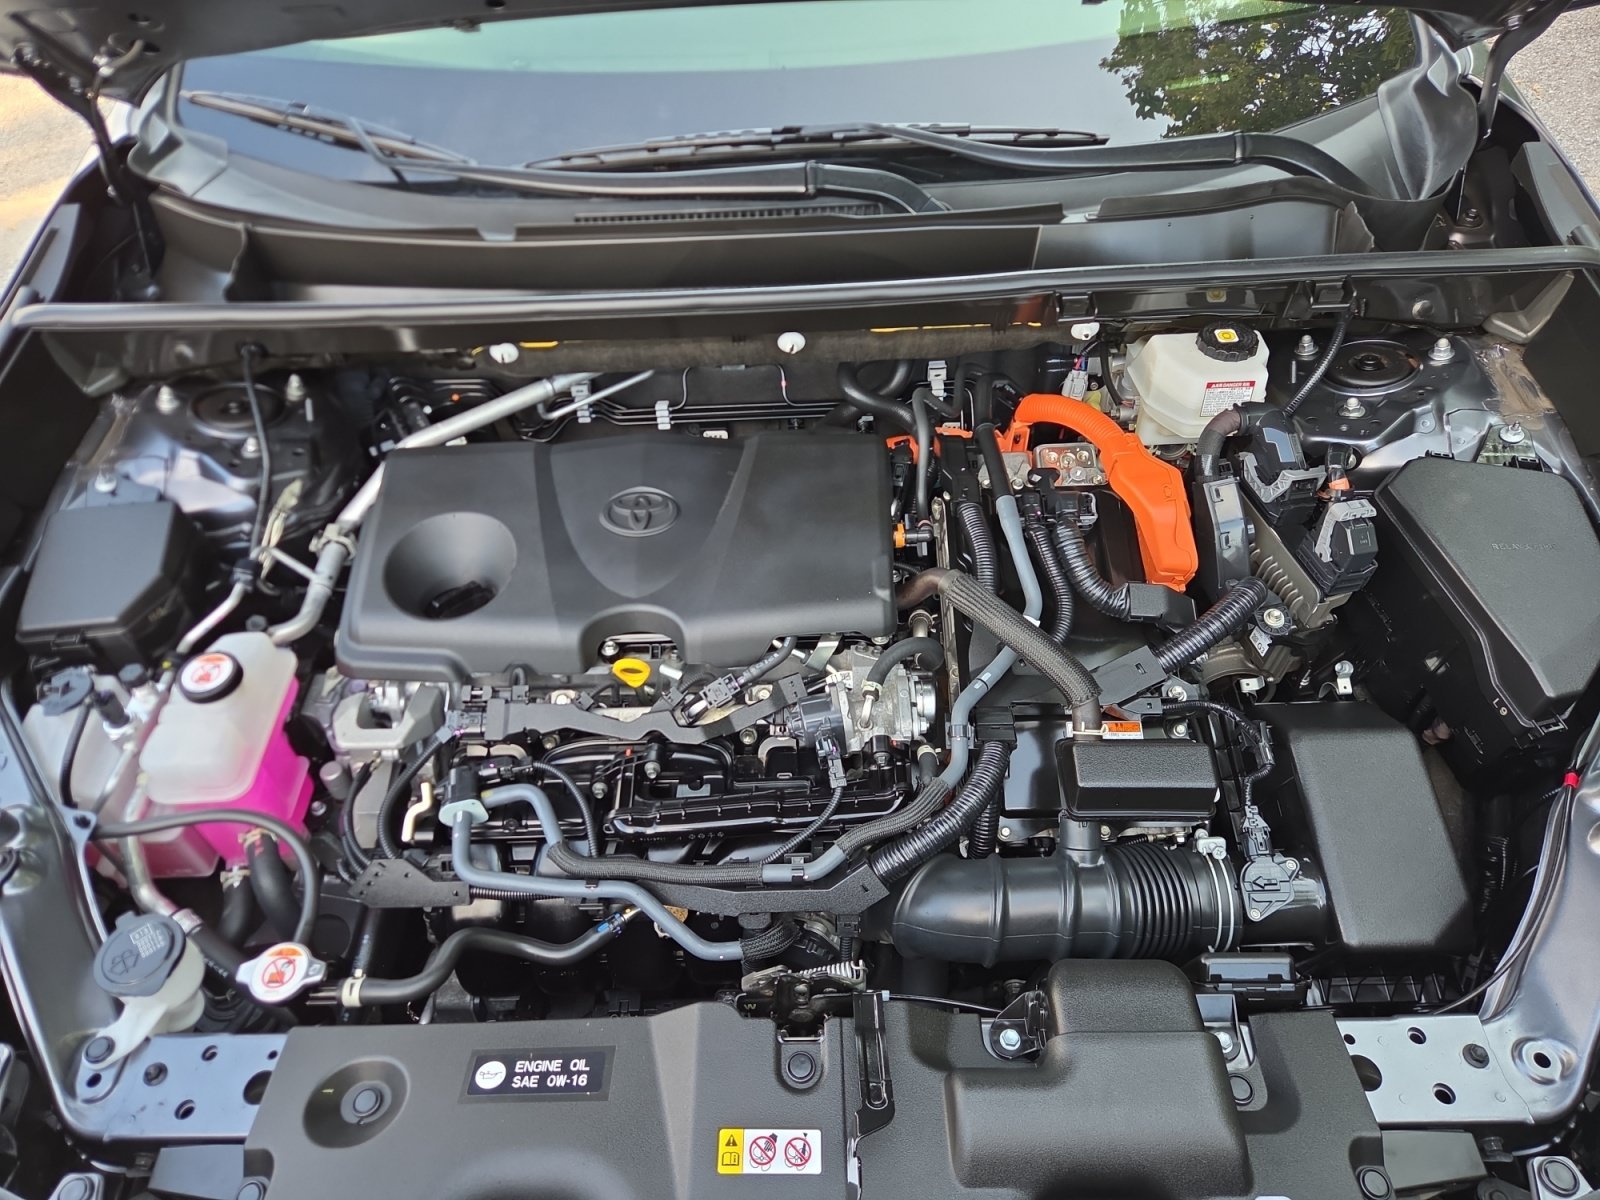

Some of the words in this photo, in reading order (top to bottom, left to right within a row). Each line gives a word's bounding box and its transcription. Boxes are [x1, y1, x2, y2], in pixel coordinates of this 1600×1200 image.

[514, 1059, 563, 1073] ENGINE
[569, 1058, 591, 1072] OIL
[511, 1075, 540, 1088] SAE
[546, 1074, 589, 1088] 0W-16
